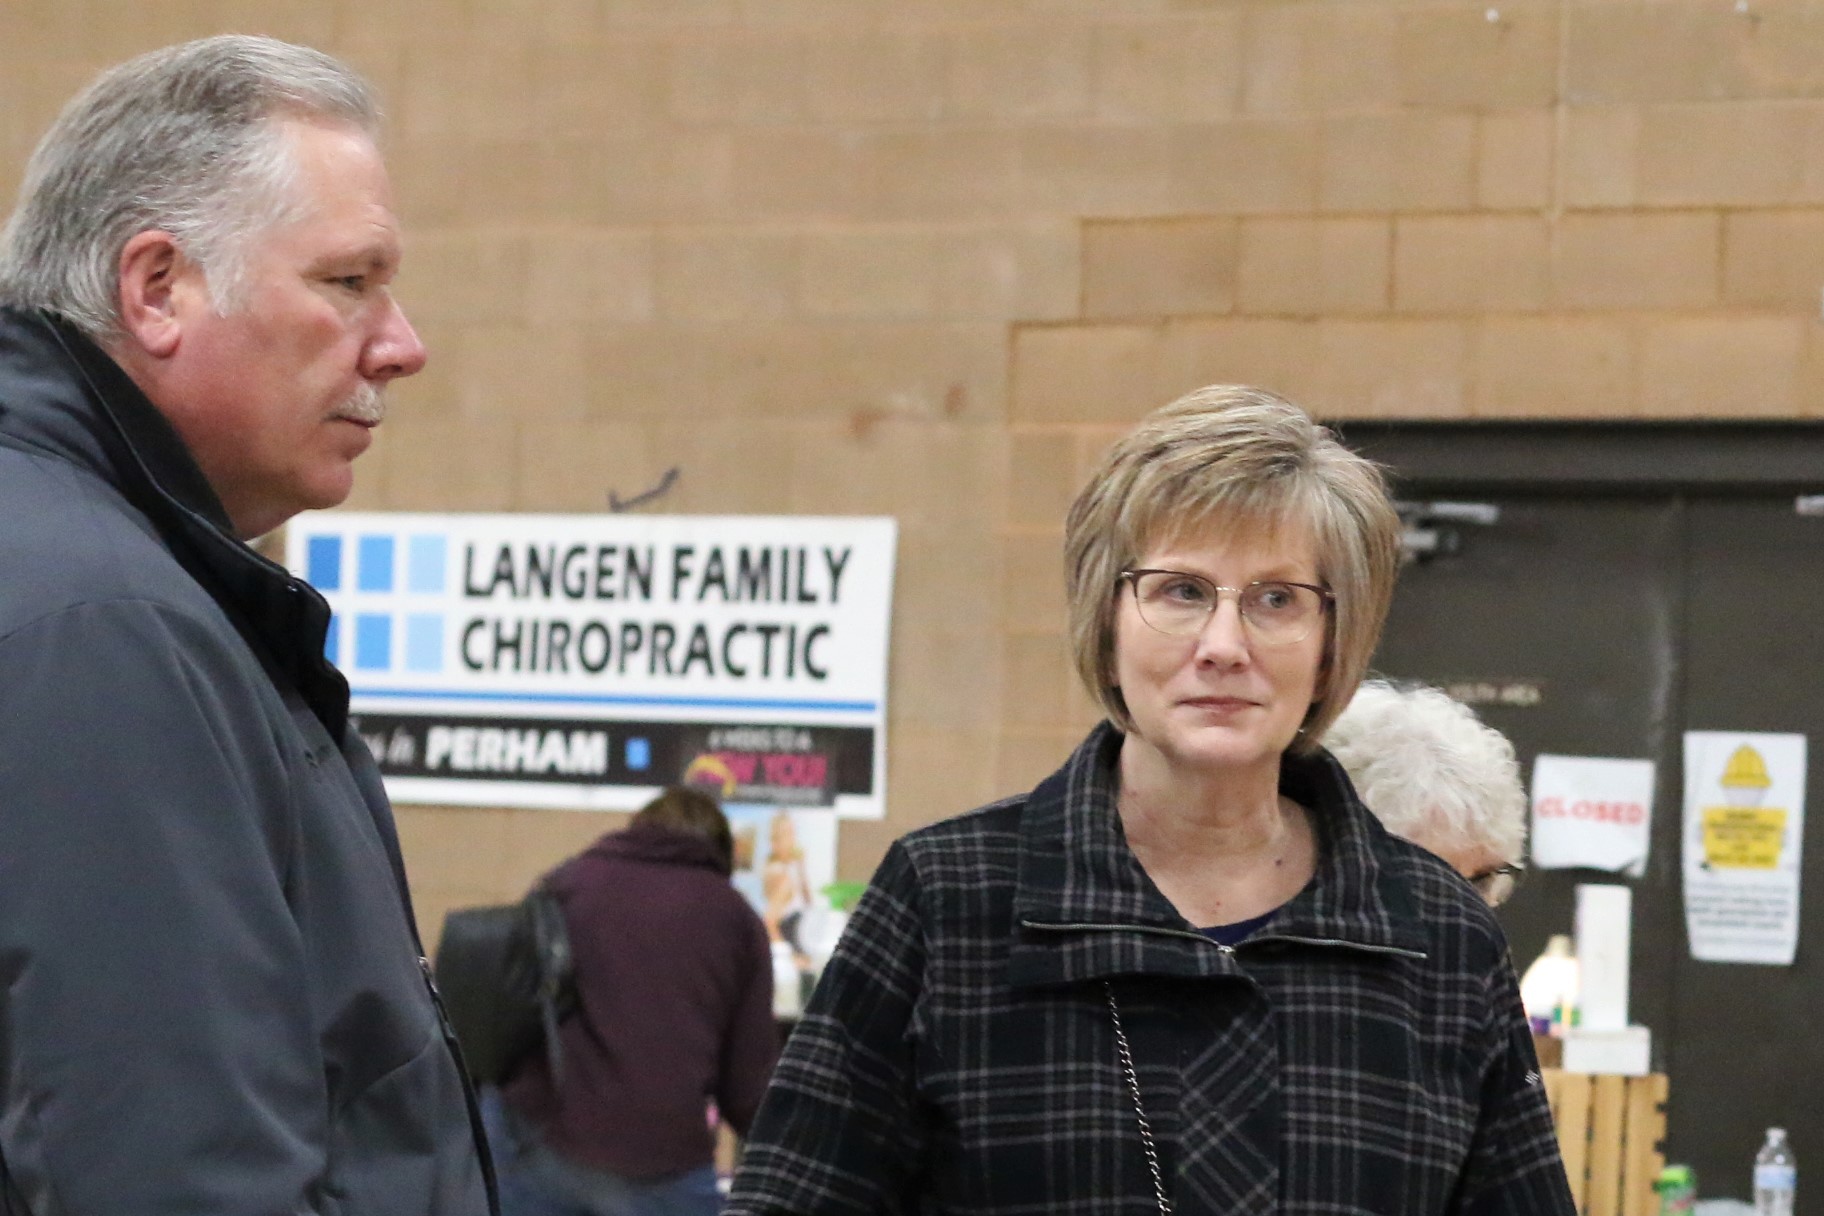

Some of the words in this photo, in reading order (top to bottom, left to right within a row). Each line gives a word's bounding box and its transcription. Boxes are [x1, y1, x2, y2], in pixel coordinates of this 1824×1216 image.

[463, 543, 656, 600] LANGEN
[671, 545, 853, 603] FAMILY
[460, 617, 832, 681] CHIROPRACTIC
[424, 725, 609, 774] PERHAM
[1536, 796, 1645, 827] CLOSED
